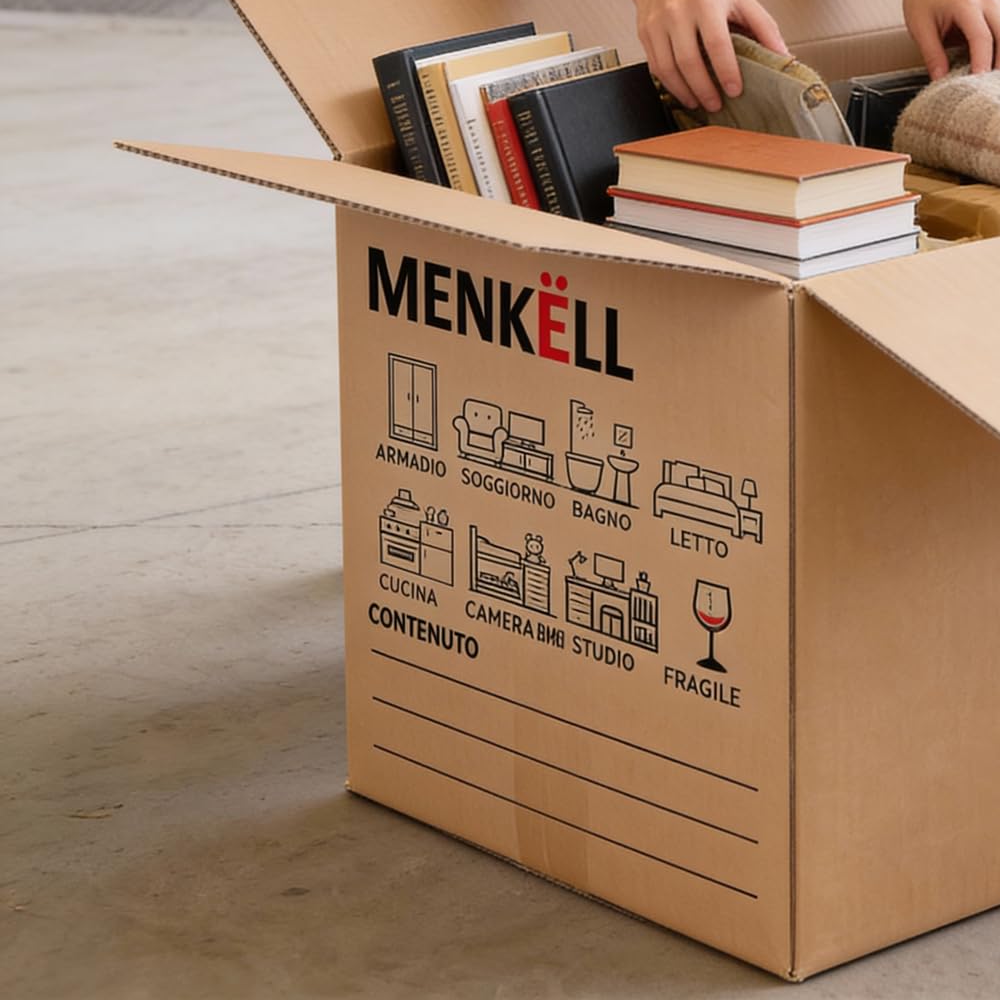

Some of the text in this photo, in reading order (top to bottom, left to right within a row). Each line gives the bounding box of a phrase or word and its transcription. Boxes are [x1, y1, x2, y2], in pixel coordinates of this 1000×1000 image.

[367, 246, 635, 382] MENKËLL
[375, 443, 447, 478] ARMADIO
[461, 467, 556, 510] SOGGIORNO
[572, 500, 632, 532] BAGNO
[670, 527, 729, 559] LETTO
[379, 572, 439, 608] CUCINA
[368, 602, 479, 659] CONTENUTO
[464, 600, 535, 640] CAMERA
[571, 635, 635, 672] STUDIO
[663, 665, 742, 709] FRAGILE
